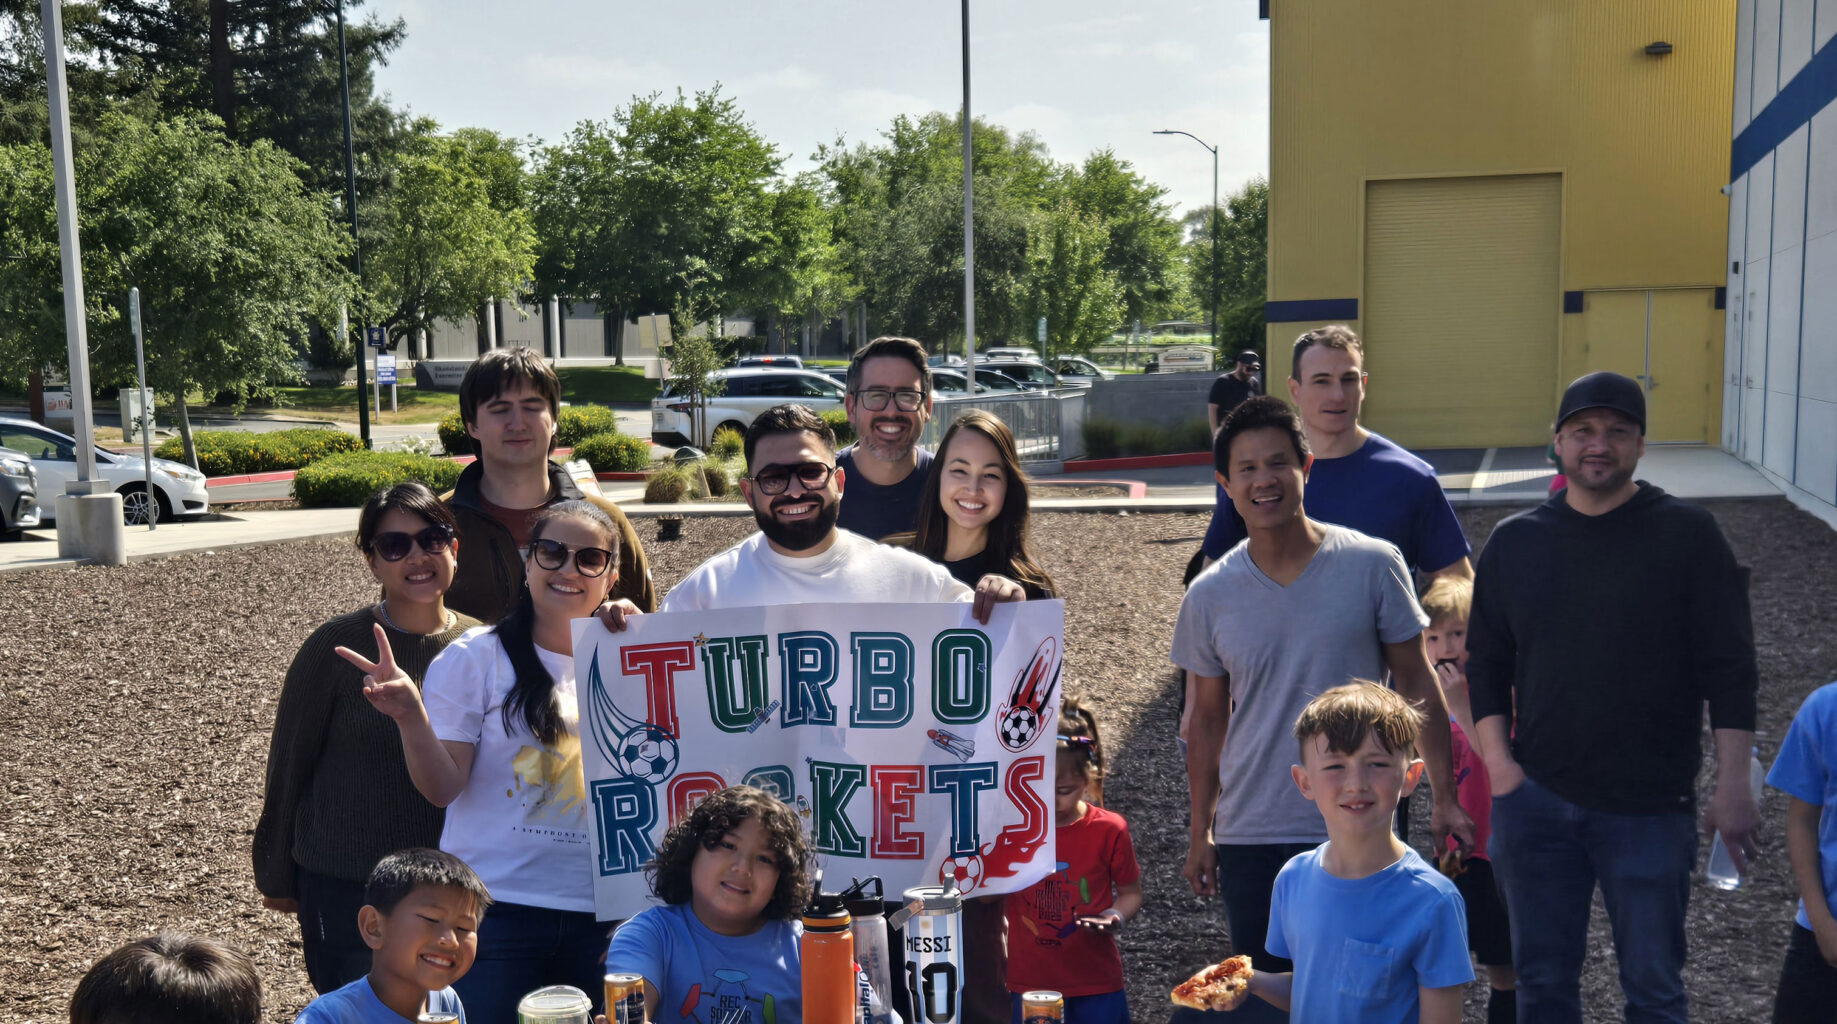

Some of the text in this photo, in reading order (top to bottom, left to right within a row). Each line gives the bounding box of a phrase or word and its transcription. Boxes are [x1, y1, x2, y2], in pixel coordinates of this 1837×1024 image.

[620, 628, 992, 739] TURBO
[906, 935, 952, 953] MESSI
[719, 994, 741, 1010] REC
[905, 960, 958, 1024] 10
